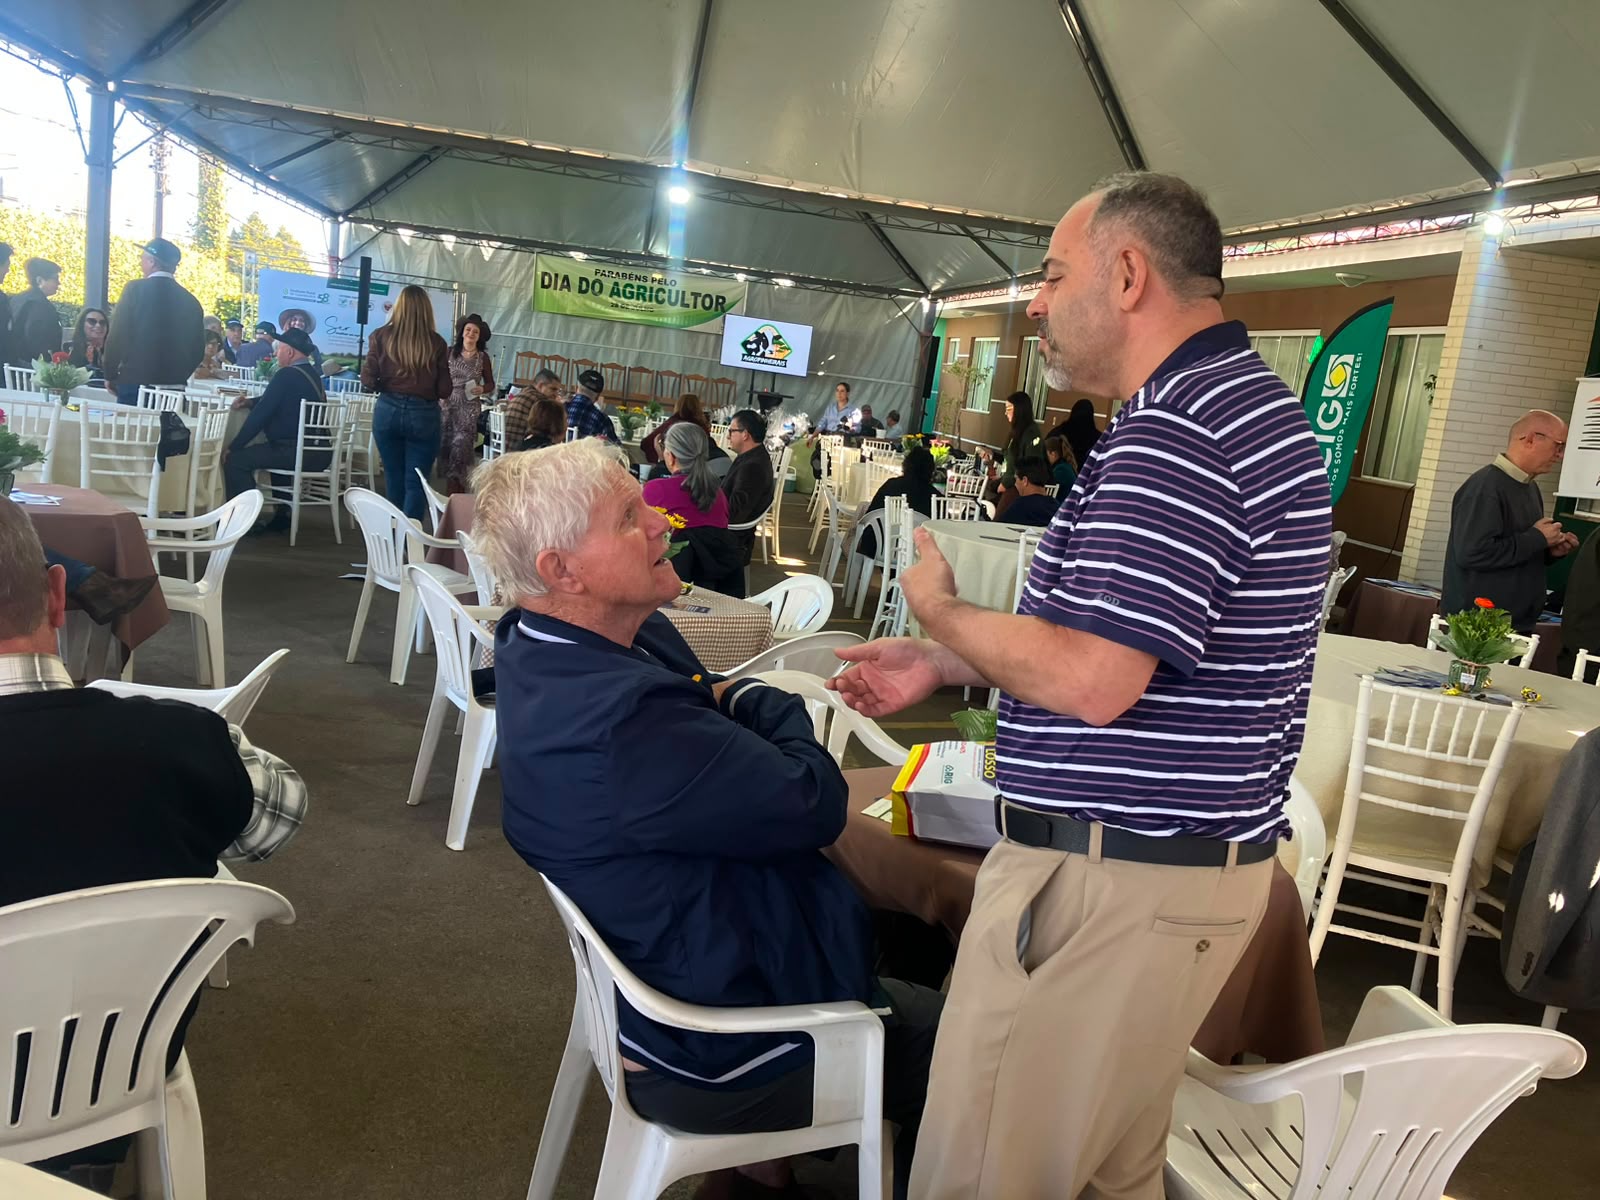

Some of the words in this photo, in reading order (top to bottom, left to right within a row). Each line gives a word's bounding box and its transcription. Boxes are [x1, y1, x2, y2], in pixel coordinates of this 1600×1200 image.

[540, 271, 571, 293] DIA
[578, 276, 604, 297] DO
[609, 281, 726, 313] AGRICULTOR
[594, 268, 648, 284] PARABÉNS
[651, 277, 677, 287] PELO
[1334, 429, 1345, 465] SOMOS
[1342, 400, 1354, 425] MAIS
[1348, 352, 1363, 397] FORTES!
